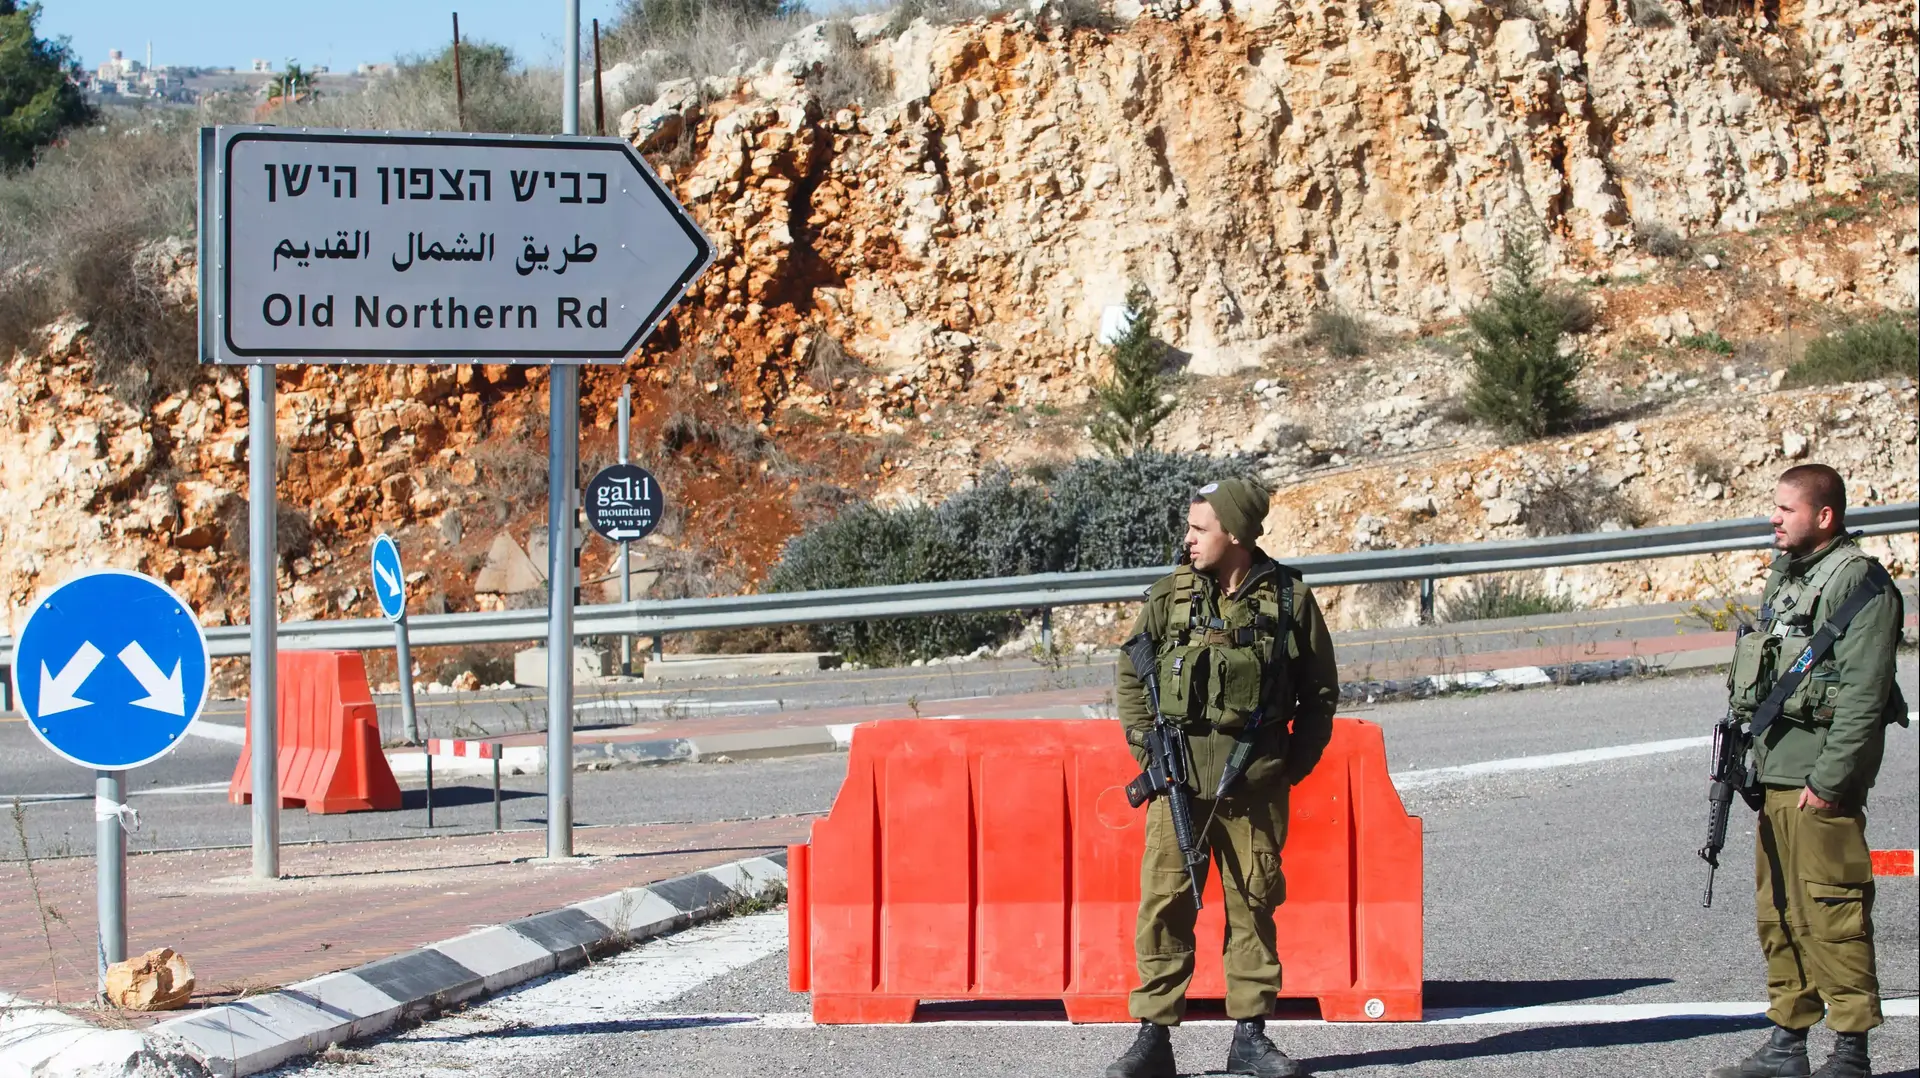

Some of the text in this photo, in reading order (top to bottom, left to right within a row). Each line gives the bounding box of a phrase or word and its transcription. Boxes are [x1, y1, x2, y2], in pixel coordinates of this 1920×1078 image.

[264, 163, 607, 205] כביש הצפון הישן
[273, 229, 598, 276] طريق الشمال القديم
[262, 293, 608, 329] Old Northern Rd
[597, 477, 651, 507] galil
[598, 507, 651, 517] mountain
[598, 518, 616, 527] גליל
[637, 519, 651, 527] יקב
